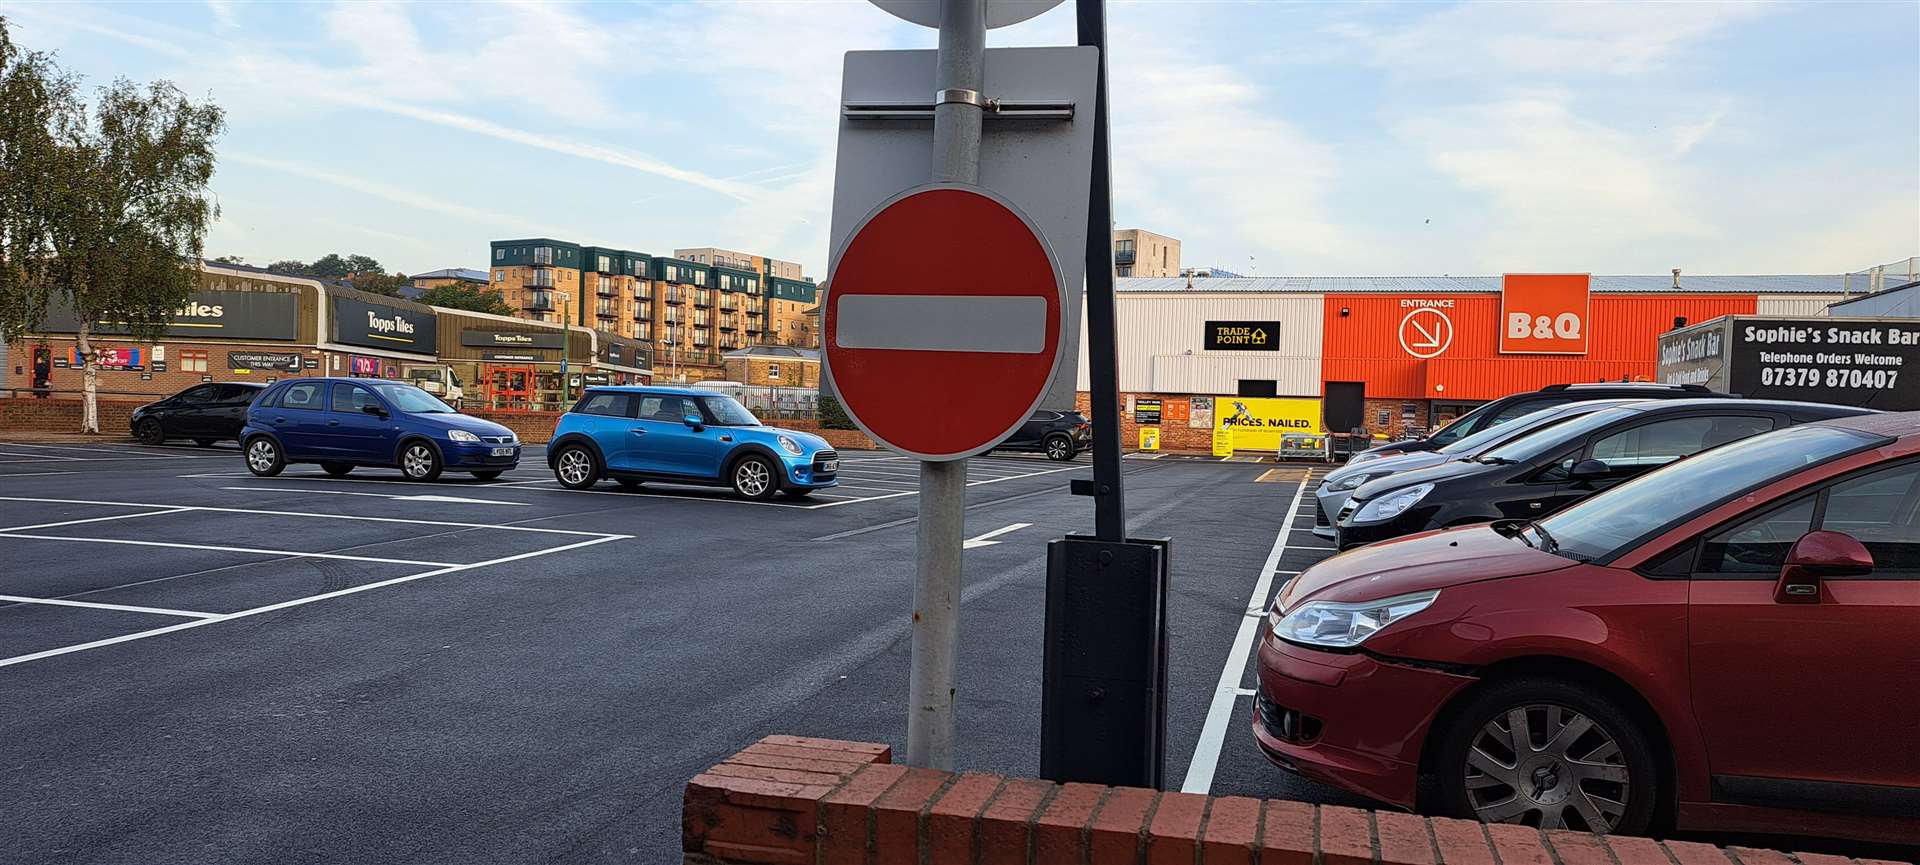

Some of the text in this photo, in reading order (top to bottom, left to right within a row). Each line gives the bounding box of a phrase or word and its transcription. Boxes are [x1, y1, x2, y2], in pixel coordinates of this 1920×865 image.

[176, 299, 224, 317] iles
[1400, 299, 1455, 308] ENTRANCE
[367, 311, 414, 334] Topps Tiles
[1508, 312, 1581, 339] B&Q
[1216, 327, 1251, 336] TRADE
[1216, 335, 1250, 344] POINT
[1744, 326, 1920, 345] Sophie's Snack Bar
[1661, 332, 1720, 367] Sophie's Snack Bar
[233, 354, 291, 363] CUSTOMER ENTRANCE
[1760, 351, 1903, 366] Telephone Orders Welcome
[1761, 367, 1899, 389] 07379 870407
[1223, 416, 1312, 429] PRICES. NAILED.
